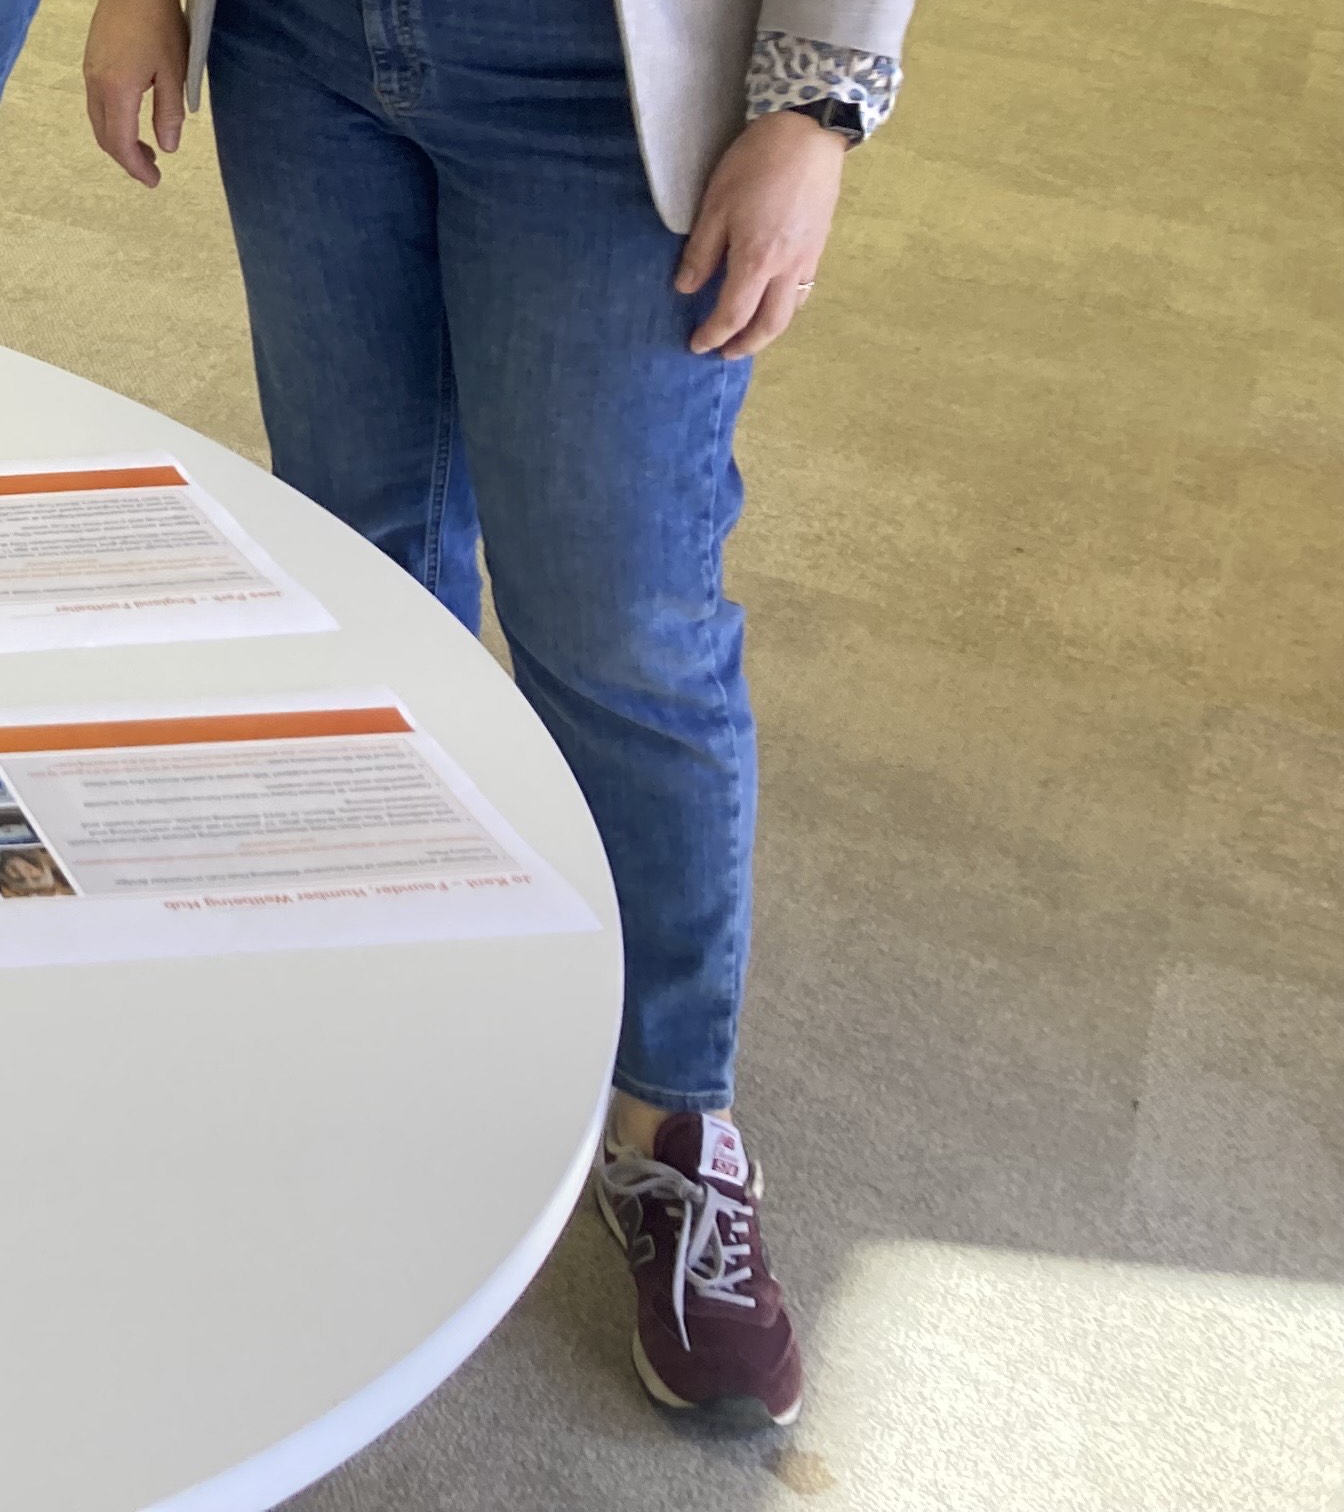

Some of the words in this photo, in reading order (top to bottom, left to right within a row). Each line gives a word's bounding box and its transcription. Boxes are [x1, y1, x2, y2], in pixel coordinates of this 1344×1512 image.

[466, 877, 510, 890] Kent
[204, 892, 292, 909] Wellbeing
[295, 888, 367, 902] Humber
[164, 899, 201, 912] Hub
